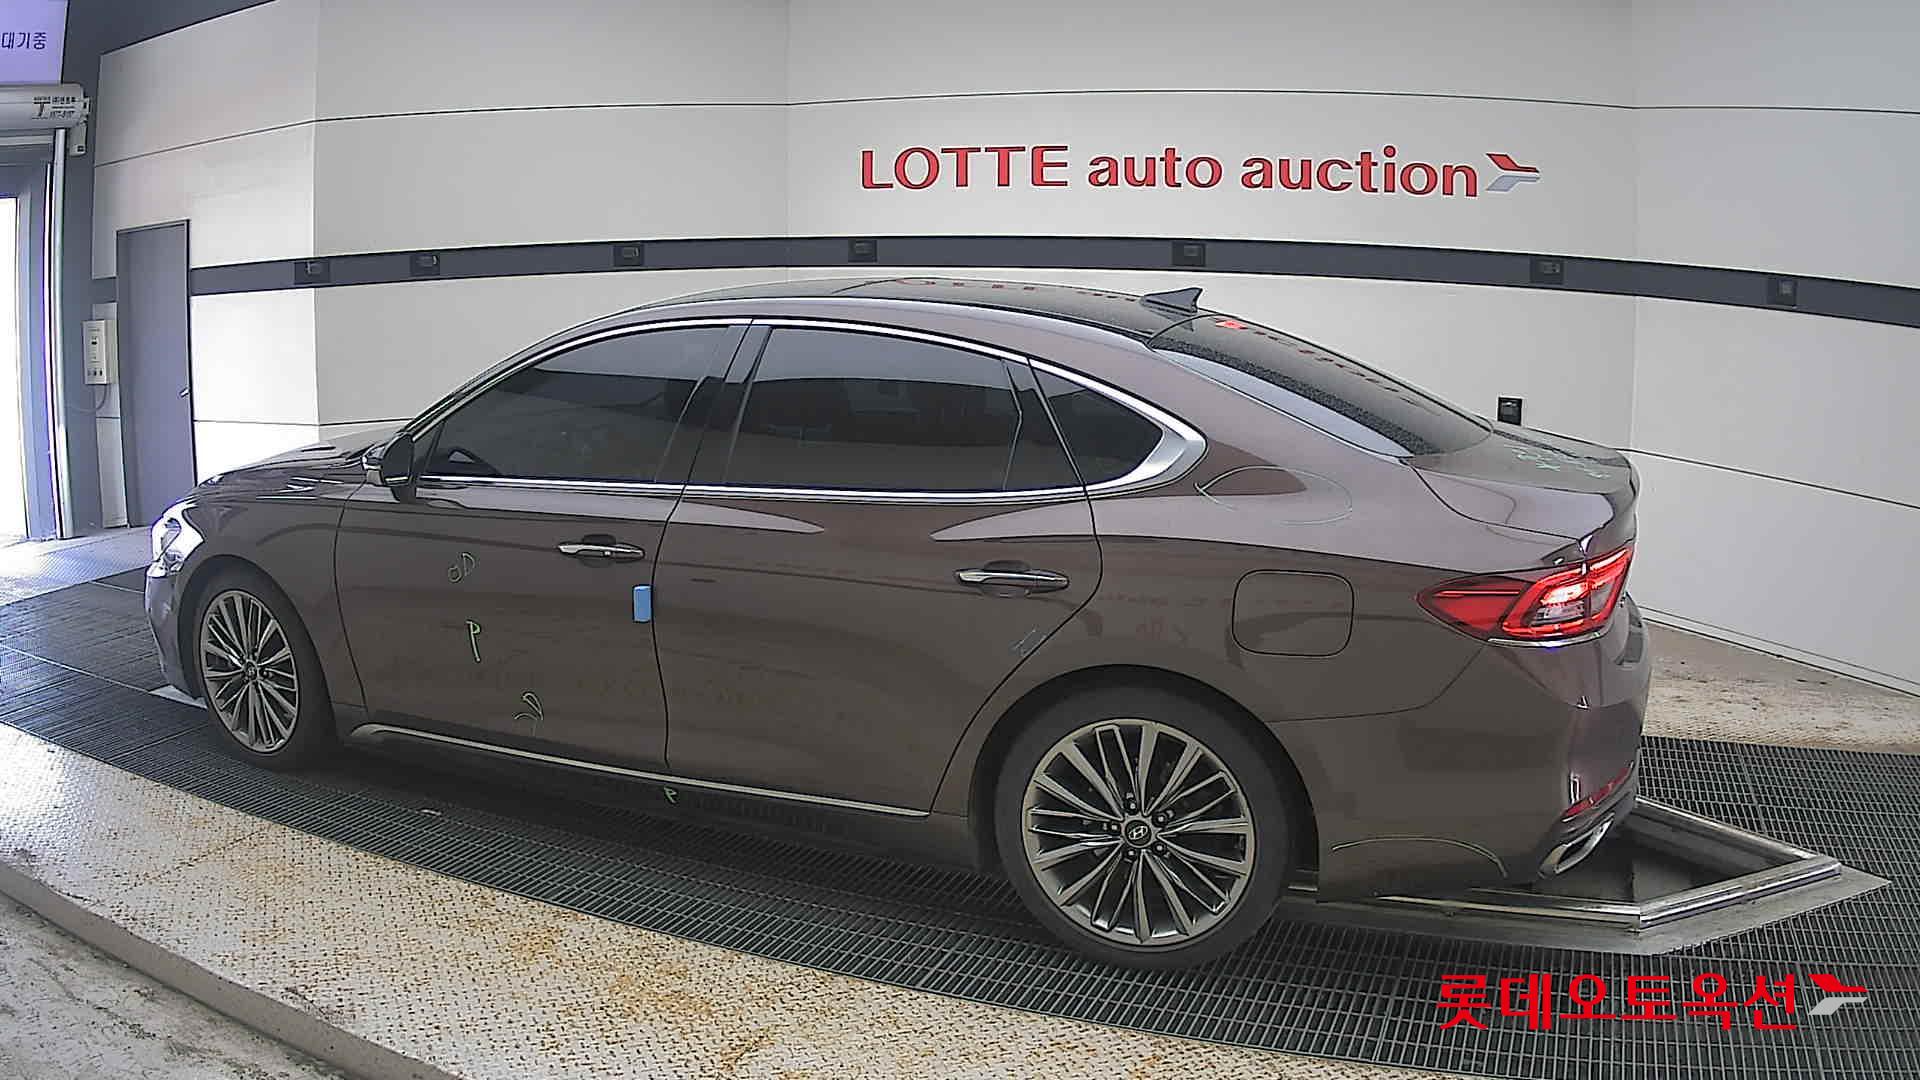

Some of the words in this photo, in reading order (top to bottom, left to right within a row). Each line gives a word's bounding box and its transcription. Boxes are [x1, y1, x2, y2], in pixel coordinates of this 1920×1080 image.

[1, 31, 47, 50] 대기중
[861, 145, 1069, 190] LOTTE
[1088, 147, 1224, 188] auto
[1241, 146, 1479, 198] auction
